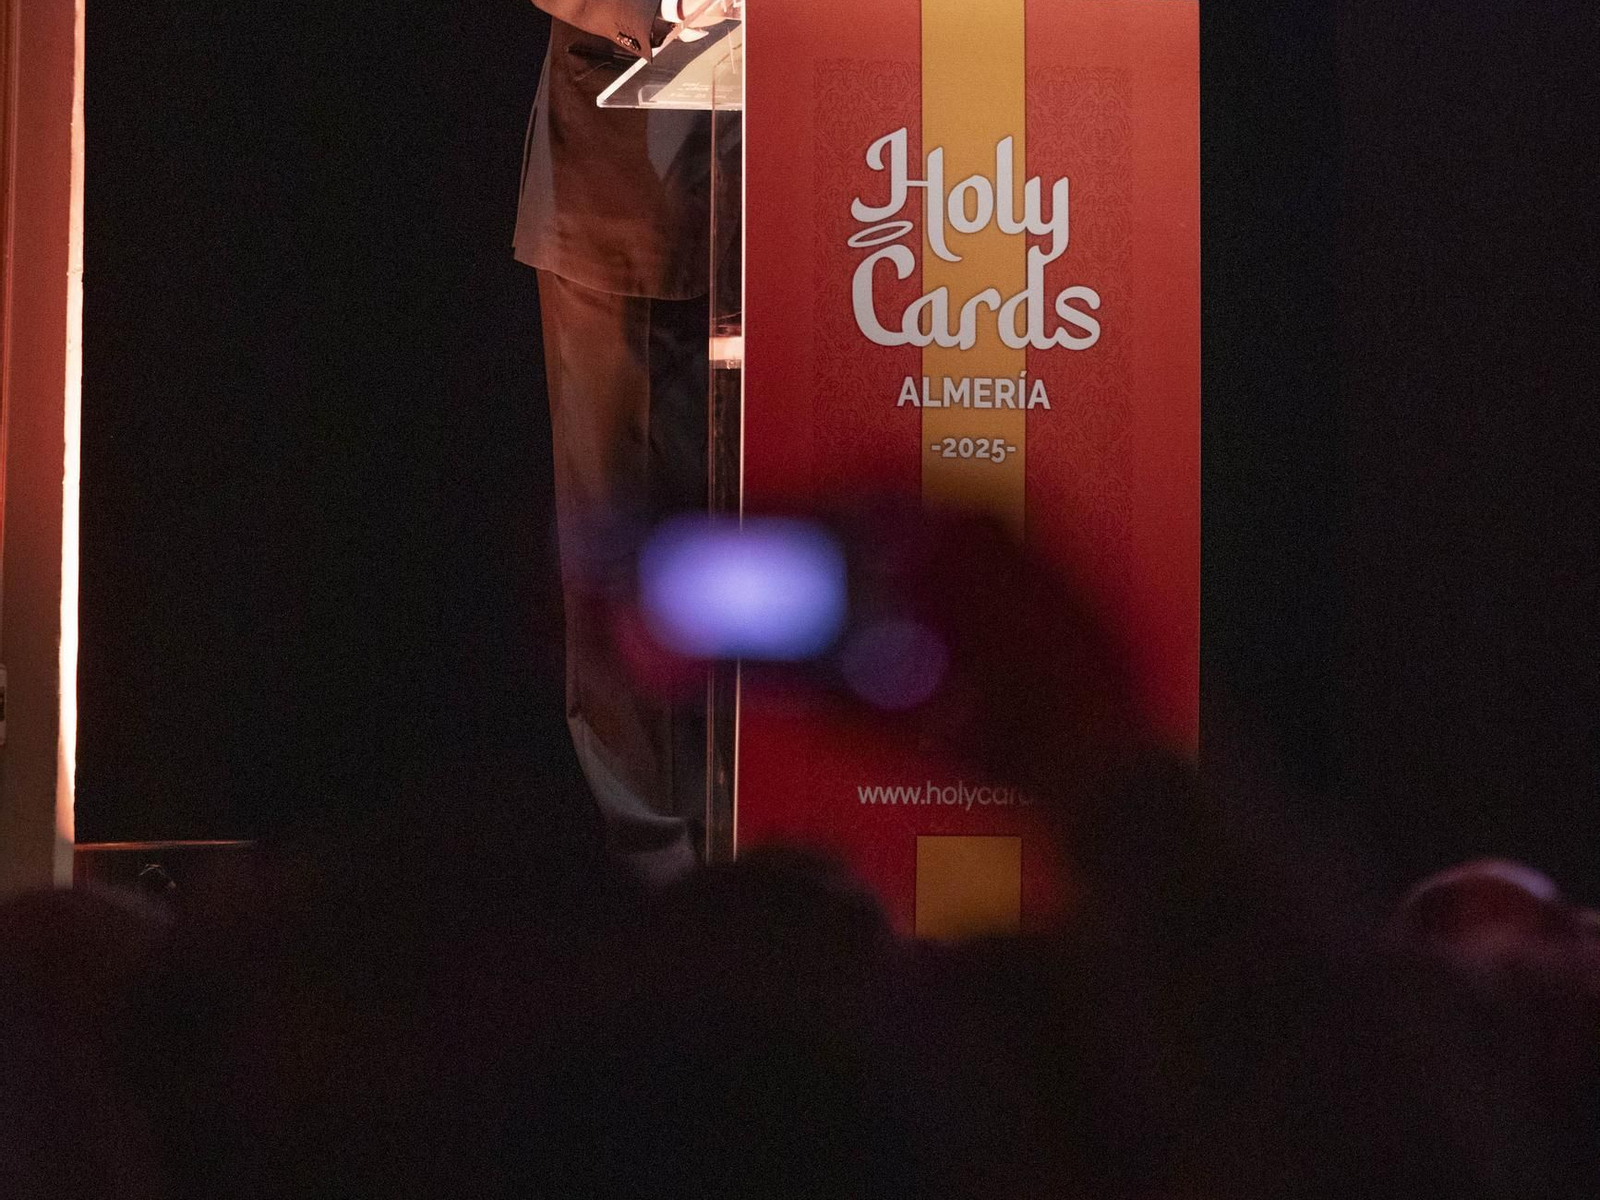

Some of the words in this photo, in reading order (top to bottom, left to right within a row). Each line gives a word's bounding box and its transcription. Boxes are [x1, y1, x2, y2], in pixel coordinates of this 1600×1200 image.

[851, 127, 1070, 266] Holy
[851, 245, 1101, 350] Cards
[897, 371, 1052, 410] ALMERÍA
[931, 437, 1016, 463] -2025-
